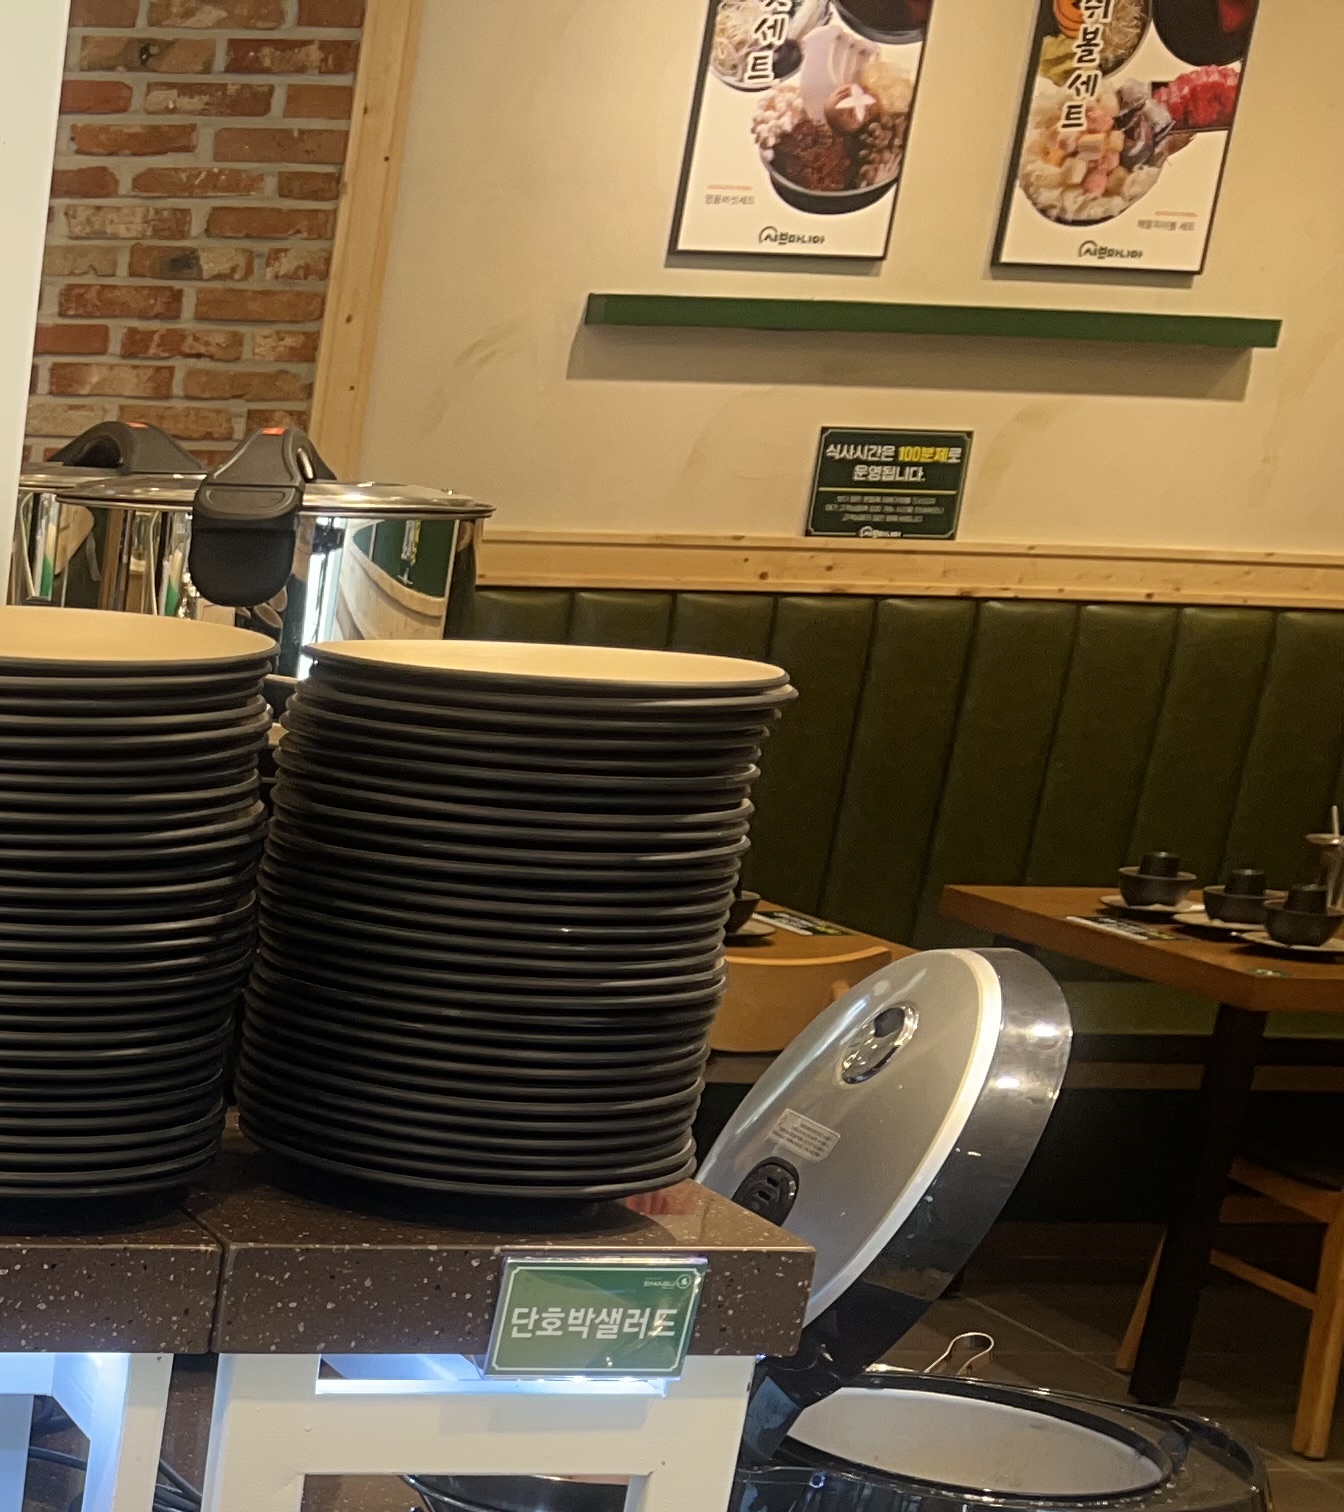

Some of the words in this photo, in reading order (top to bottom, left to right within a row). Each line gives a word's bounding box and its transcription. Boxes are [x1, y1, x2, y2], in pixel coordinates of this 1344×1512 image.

[826, 443, 896, 461] 식사시간은
[898, 445, 962, 464] 100분제로
[852, 464, 926, 482] 운영됩니다.
[510, 1306, 678, 1339] 단호박샐러드
